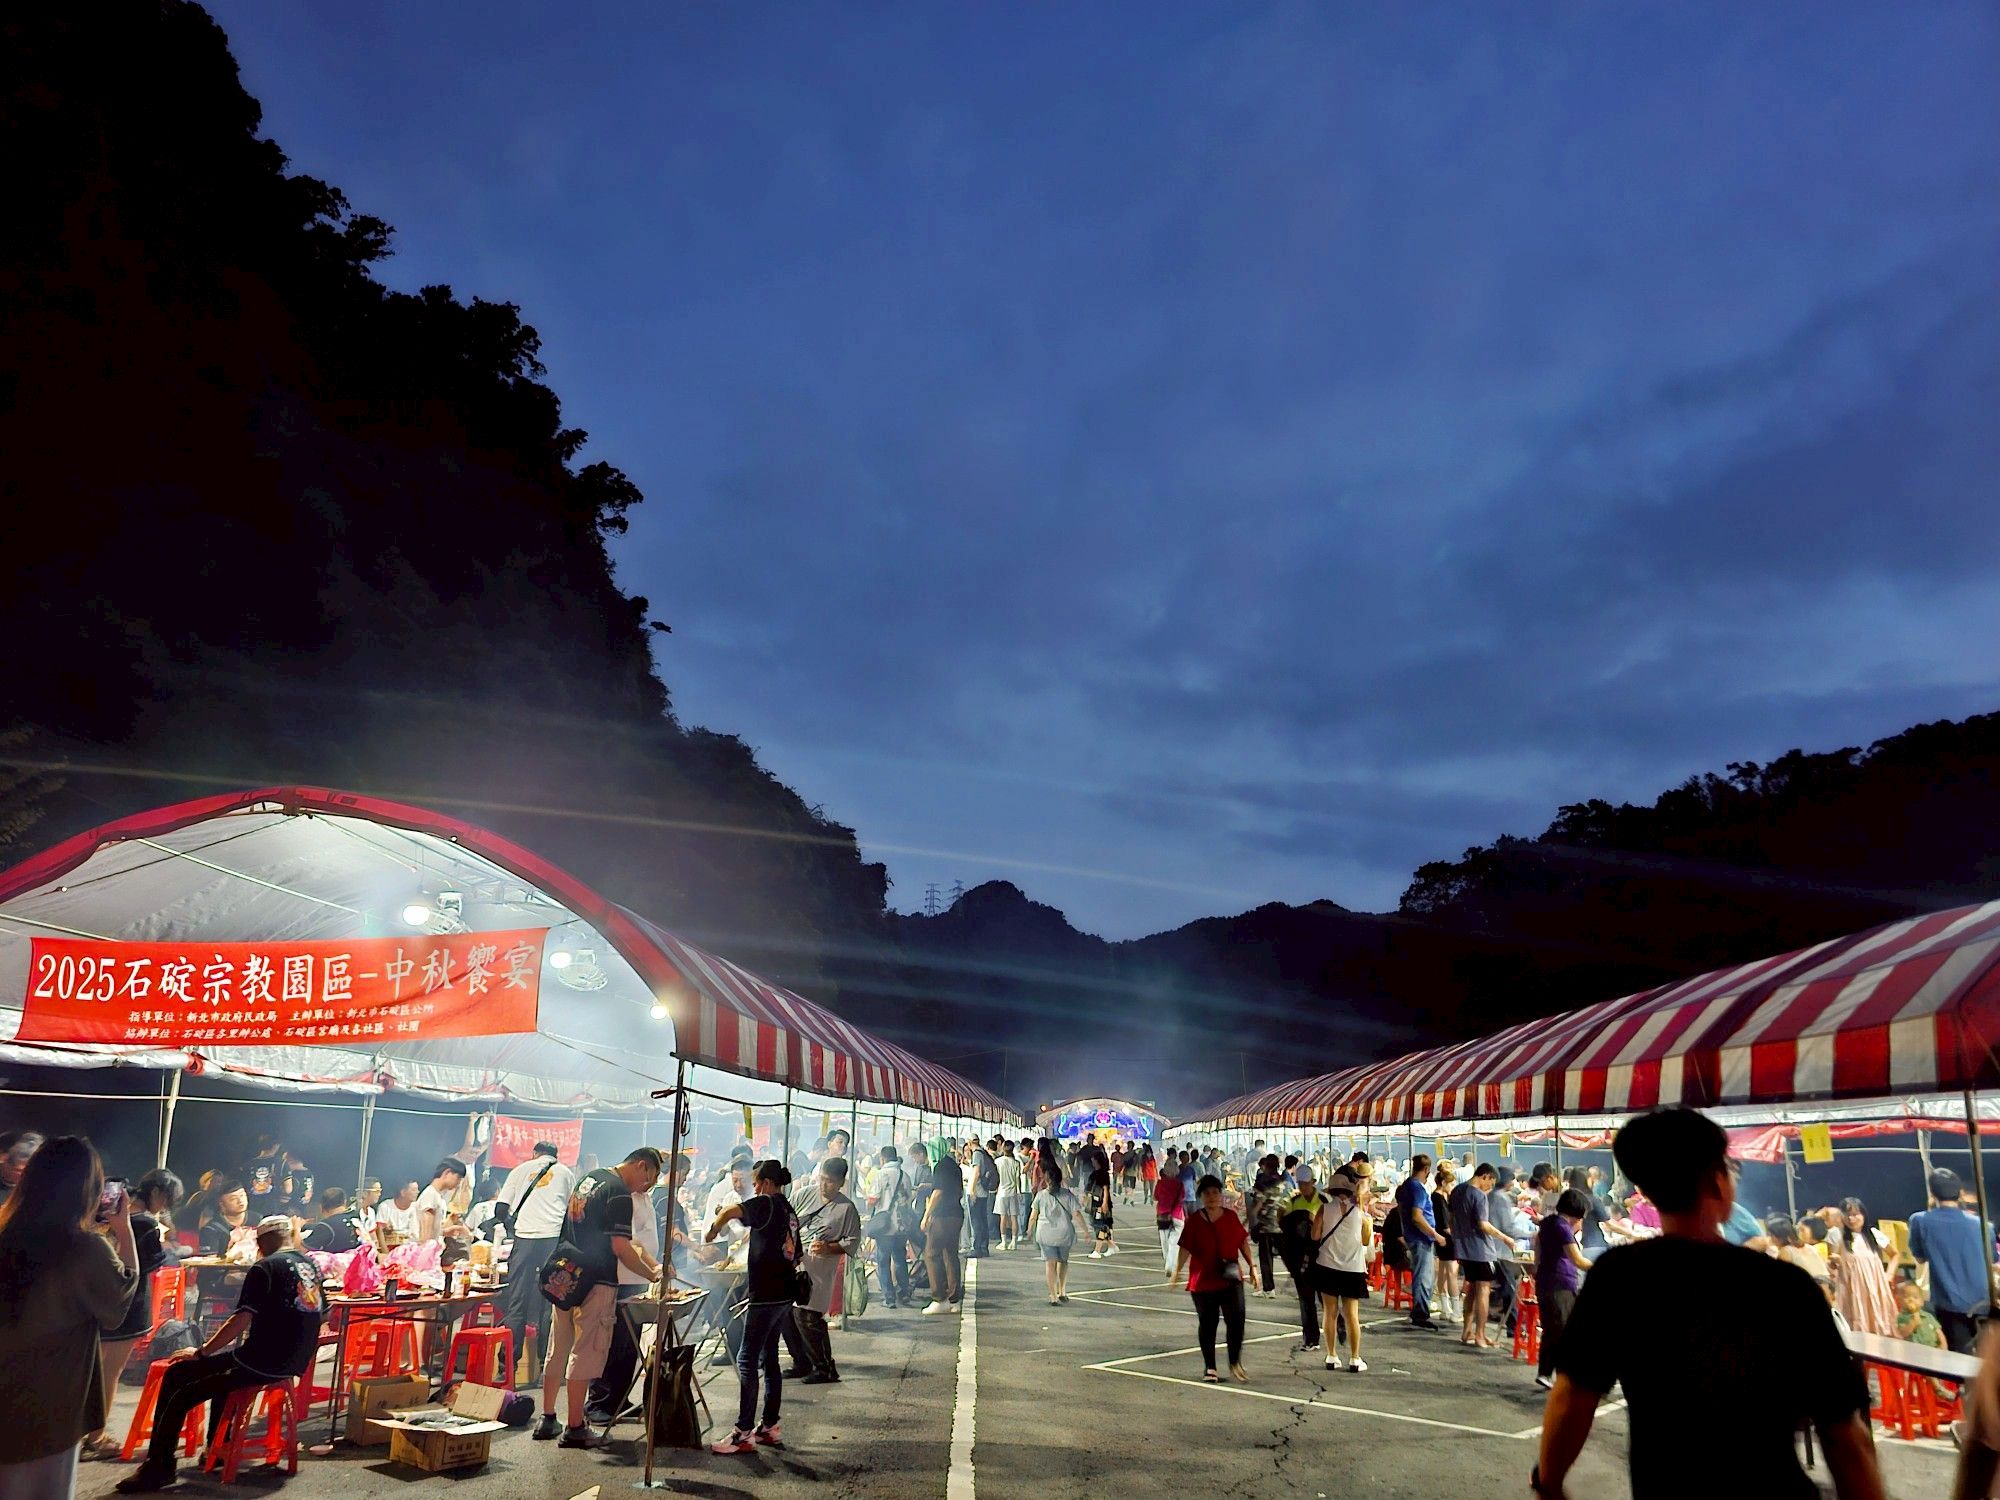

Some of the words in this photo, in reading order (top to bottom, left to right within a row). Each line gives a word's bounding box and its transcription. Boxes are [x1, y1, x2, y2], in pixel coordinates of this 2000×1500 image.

[34, 940, 537, 1006] 2025石碇宗教園區-中秋饗宴
